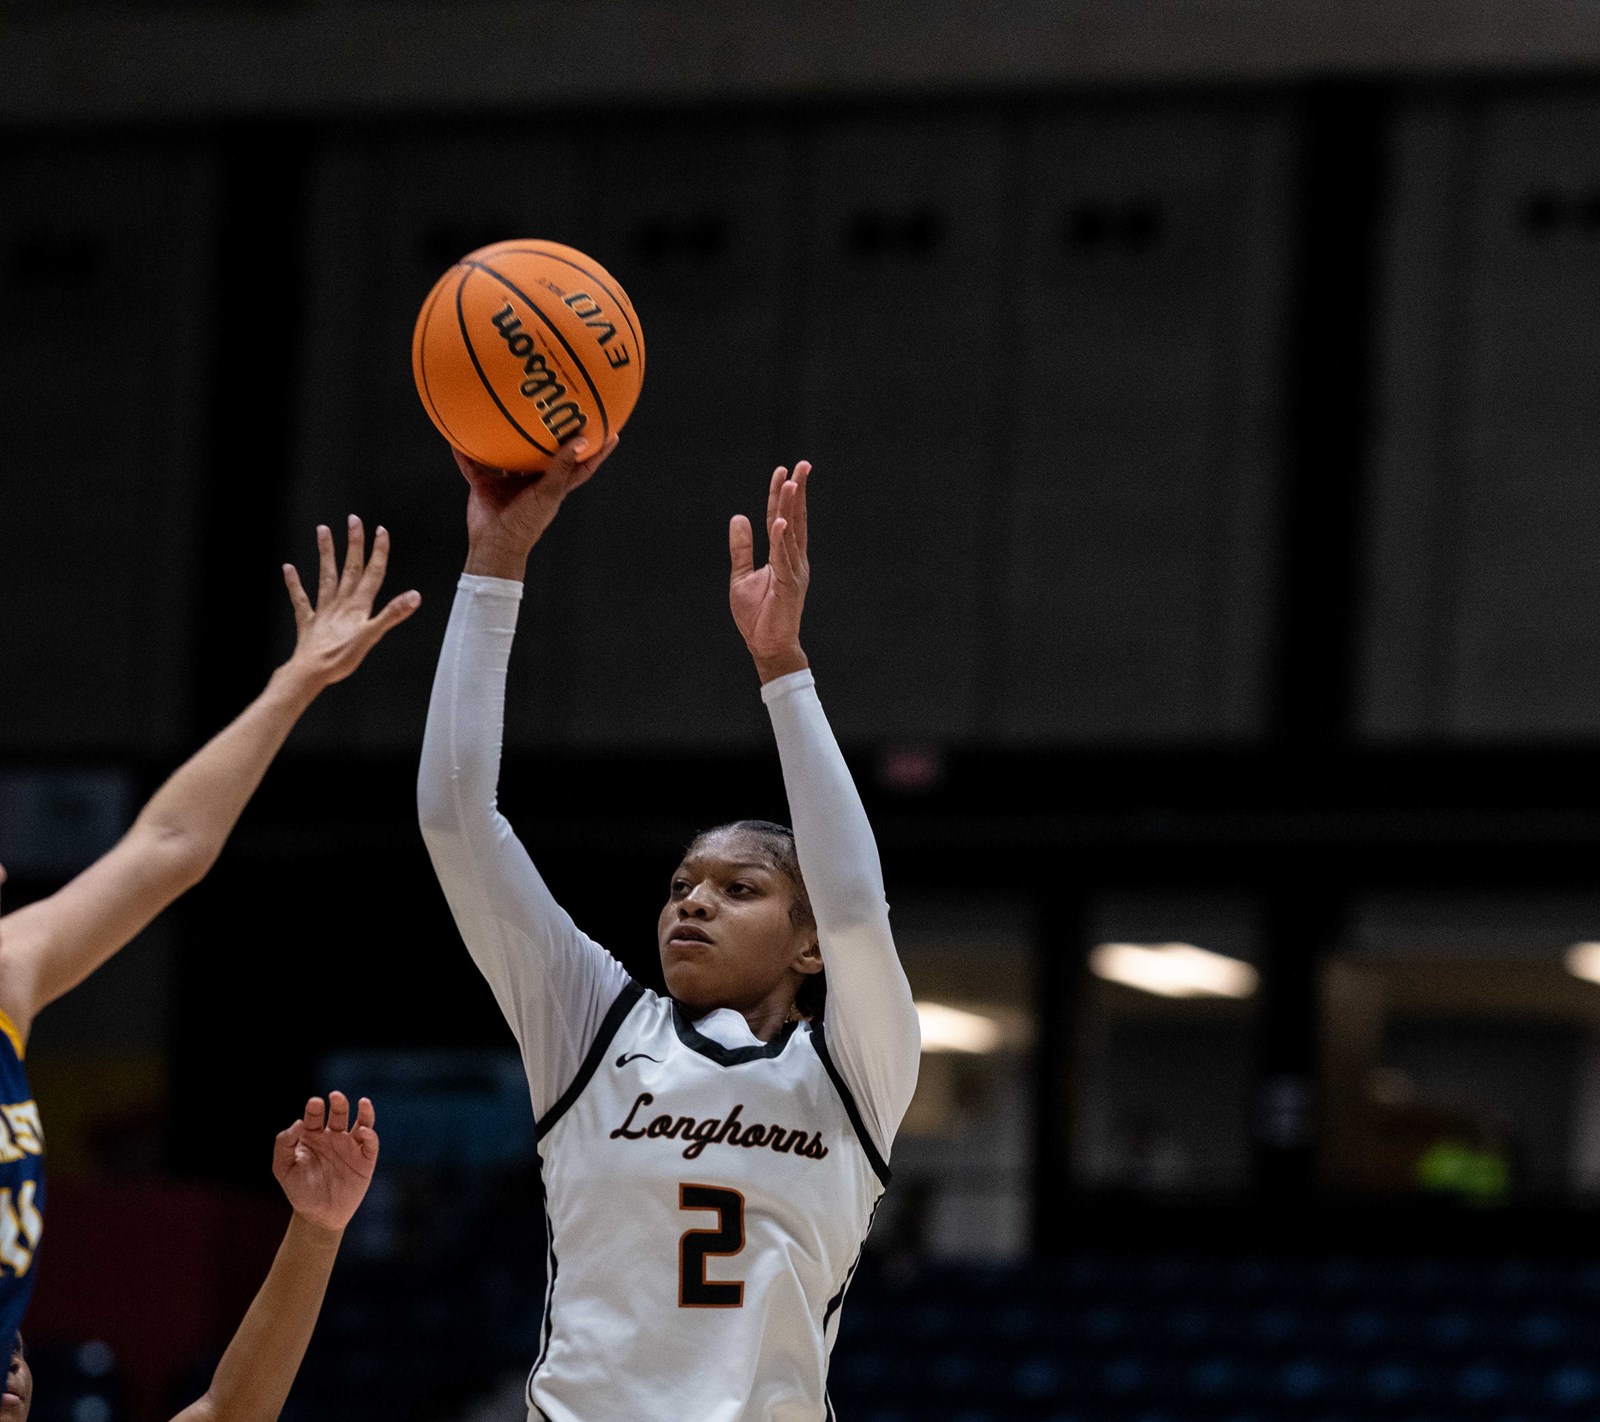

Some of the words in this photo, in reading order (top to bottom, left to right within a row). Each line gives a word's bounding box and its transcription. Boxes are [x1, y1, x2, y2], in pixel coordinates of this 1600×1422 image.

[491, 301, 588, 446] Wilson
[562, 292, 630, 369] EVO
[609, 1092, 829, 1160] Longhorns
[678, 1182, 746, 1309] 2
